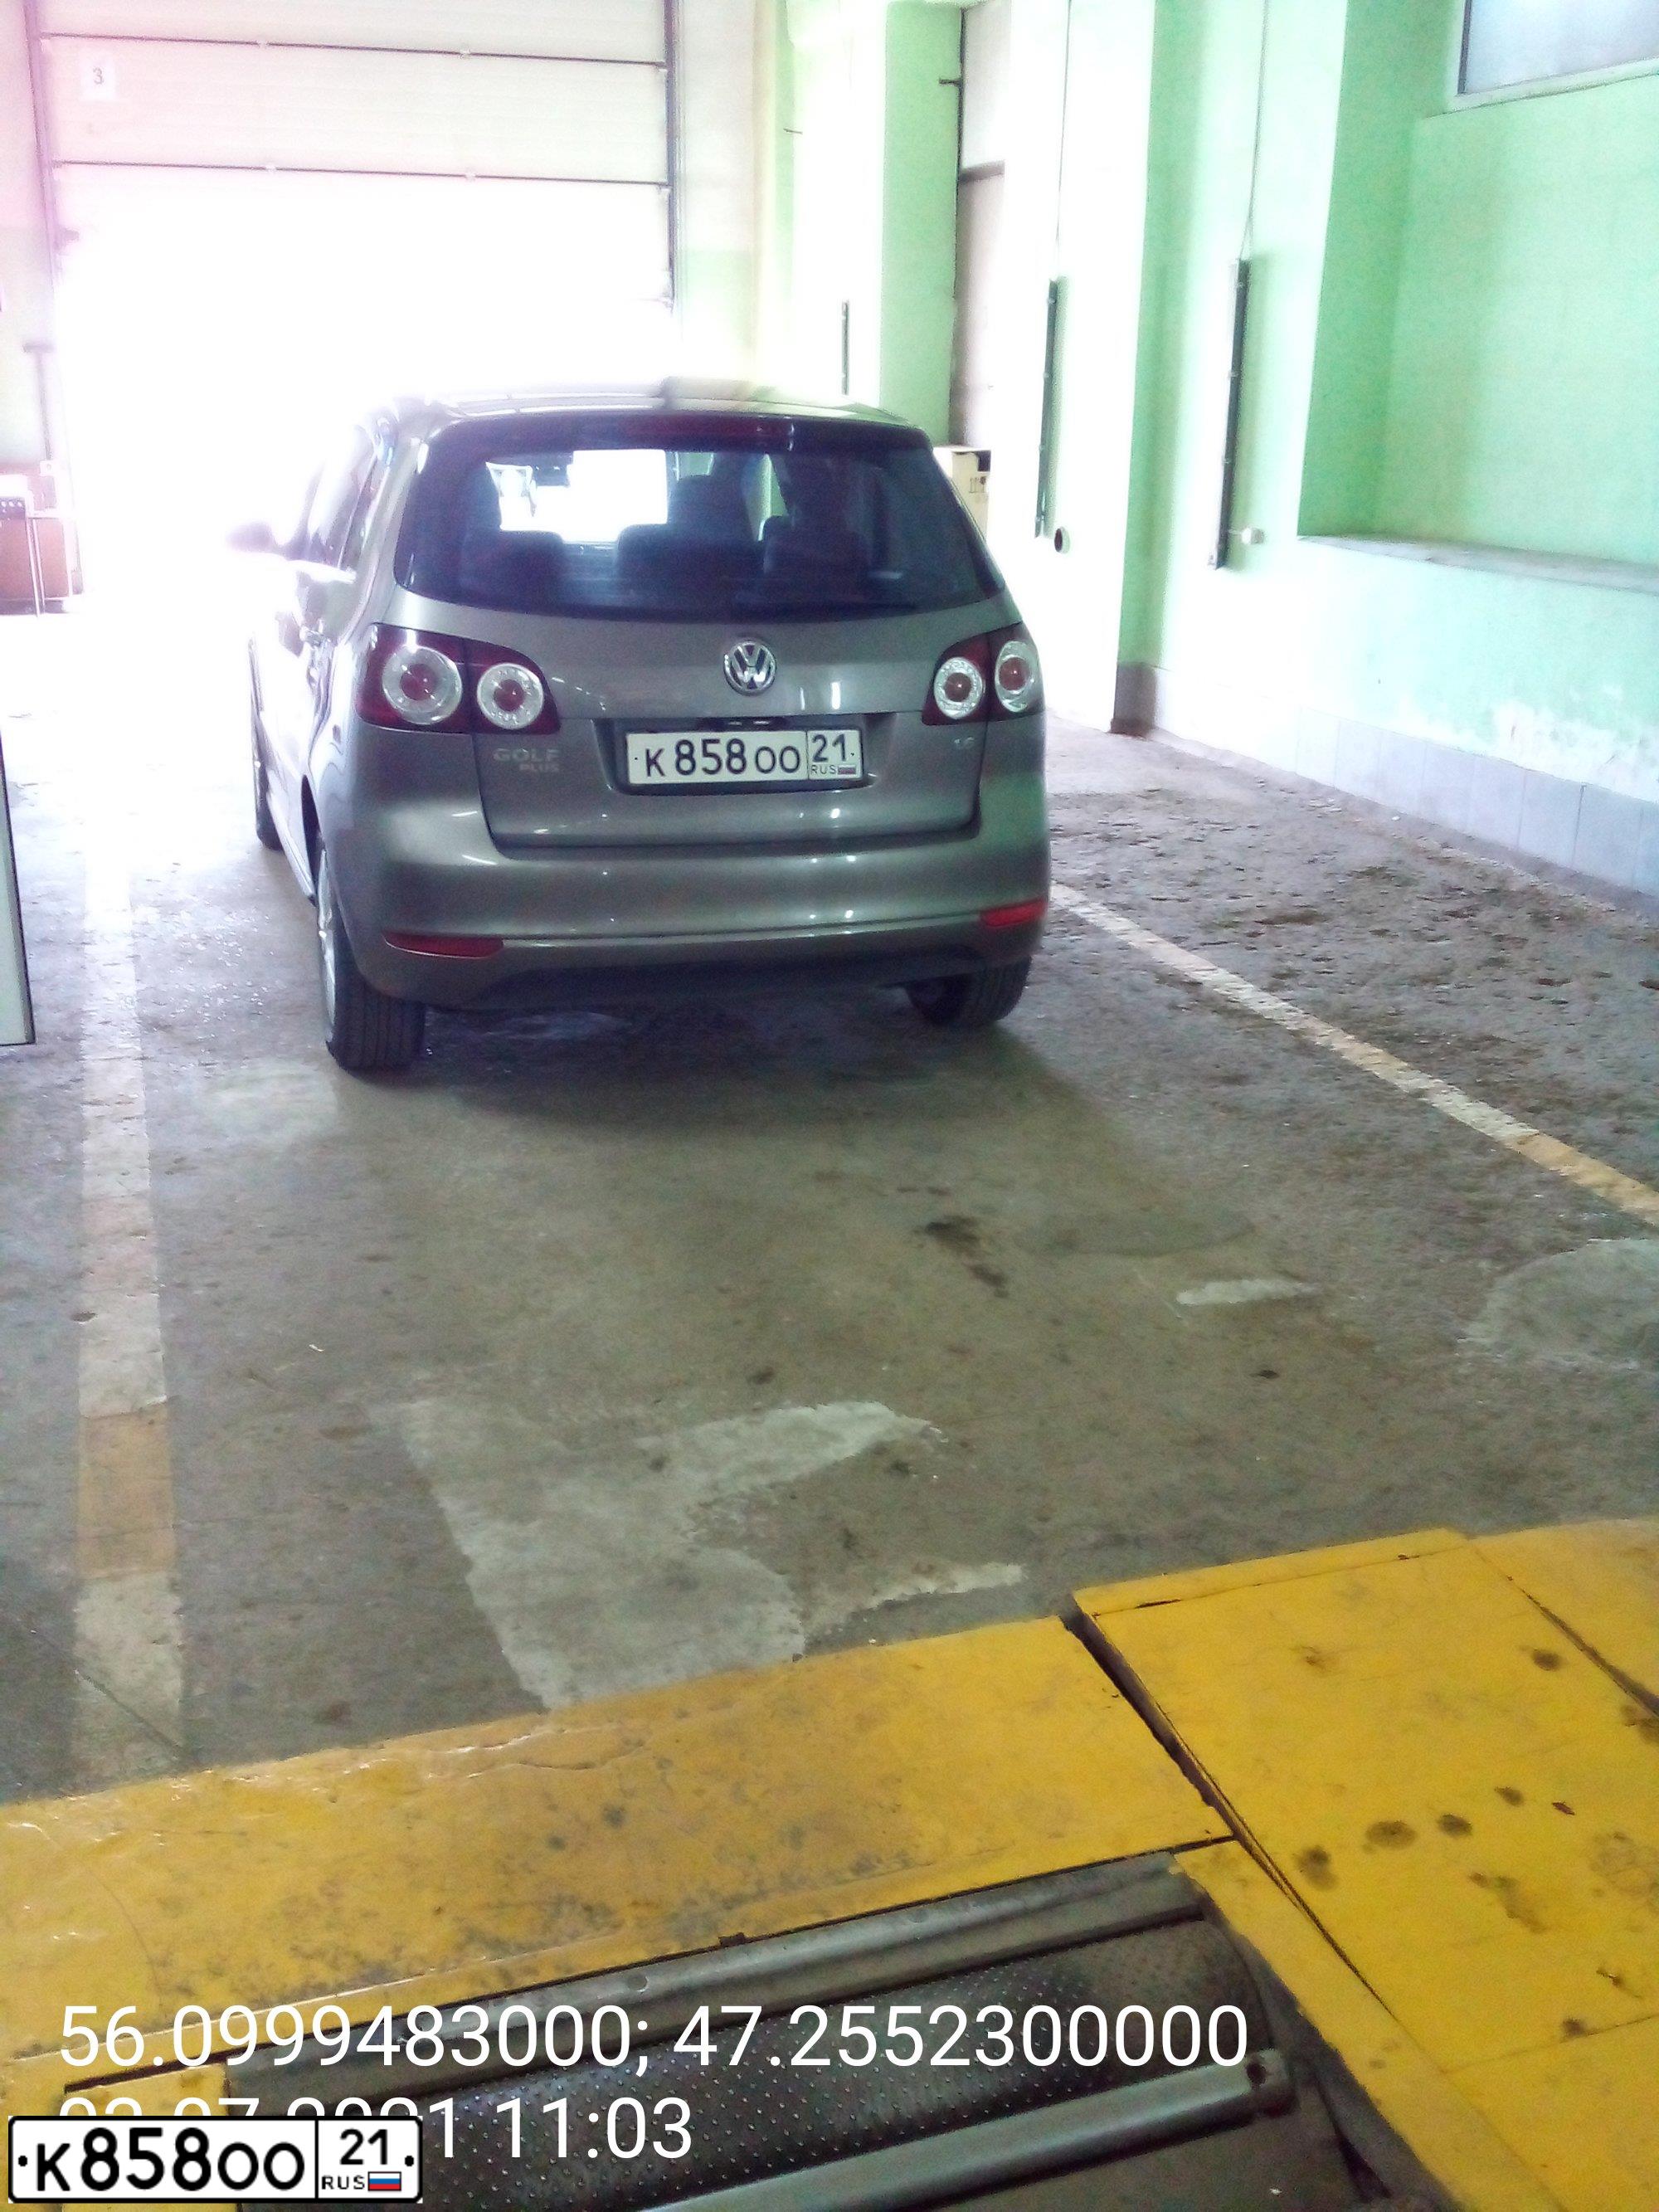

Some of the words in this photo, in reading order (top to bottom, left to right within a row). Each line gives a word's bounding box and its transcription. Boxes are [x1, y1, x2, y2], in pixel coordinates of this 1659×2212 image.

[92, 67, 105, 85] 3
[493, 748, 562, 763] GOLF
[811, 733, 846, 763] 21
[810, 764, 837, 775] RUS
